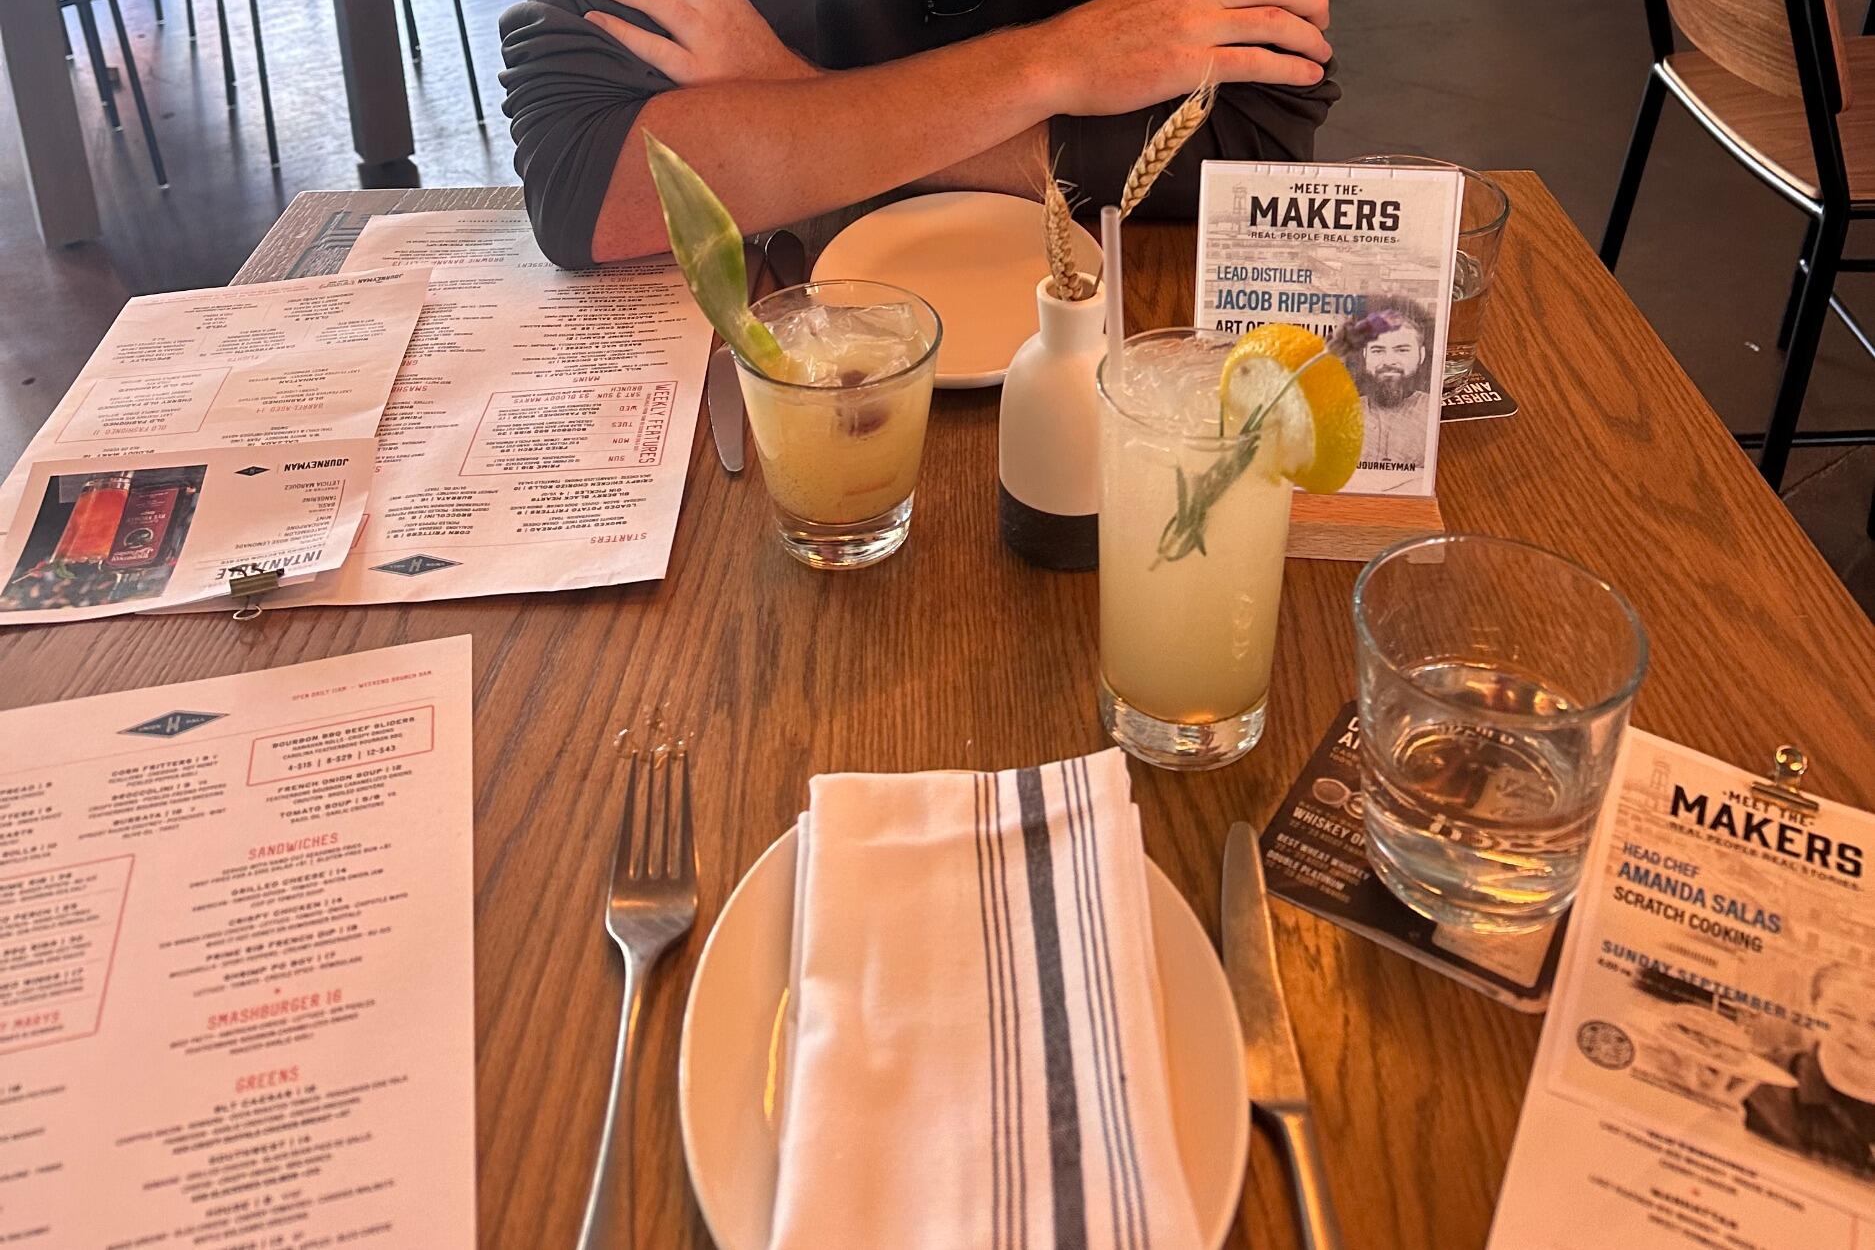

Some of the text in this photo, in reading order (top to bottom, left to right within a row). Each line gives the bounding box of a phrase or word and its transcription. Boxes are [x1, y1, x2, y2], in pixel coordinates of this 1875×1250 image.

[1294, 183, 1359, 195] MEET THE
[1249, 195, 1400, 231] MAKERS
[1250, 231, 1396, 243] REAL PEOPLE REAL STORIES
[1217, 266, 1312, 283] LEAD DISTILLER
[1215, 287, 1272, 311] JACOB
[1215, 319, 1242, 332] ART
[636, 383, 671, 463] WEEKLY FEATURES
[283, 458, 349, 471] JOURNEYMAN
[1356, 460, 1416, 472] JOURNEYMAN
[284, 479, 340, 490] LETICIA MARQUEZ
[301, 494, 336, 502] TANGERINE
[234, 539, 270, 548] LEMONADE
[589, 532, 647, 543] STARTERS
[271, 716, 415, 748] BOURBON BBQ BEEF SLIDERS
[111, 758, 192, 777] CORN FRITTERS
[277, 780, 318, 793] FRENCH
[321, 773, 352, 785] ONION
[355, 767, 382, 778] SOUP
[110, 785, 173, 801] BROCCOLINI
[279, 799, 352, 818] TOMATO SOUP
[1291, 805, 1350, 840] WHISKEY
[1665, 784, 1870, 879] MAKERS
[247, 832, 339, 860] SANDWICHES
[1275, 832, 1370, 882] BEST WHEAT WHISKEY
[1266, 847, 1300, 871] DOUBLE
[1298, 863, 1345, 892] PLATINUM
[1621, 840, 1701, 880] HEAD CHEF
[1617, 860, 1785, 935] AMANDA SALAS
[1611, 885, 1765, 954] SCRATCH COOKING
[1600, 939, 1673, 977] SUNDAY
[1676, 967, 1786, 1017] SEPTEMBER
[205, 993, 321, 1030] SMASHBURGER
[234, 1065, 300, 1091] GREENS
